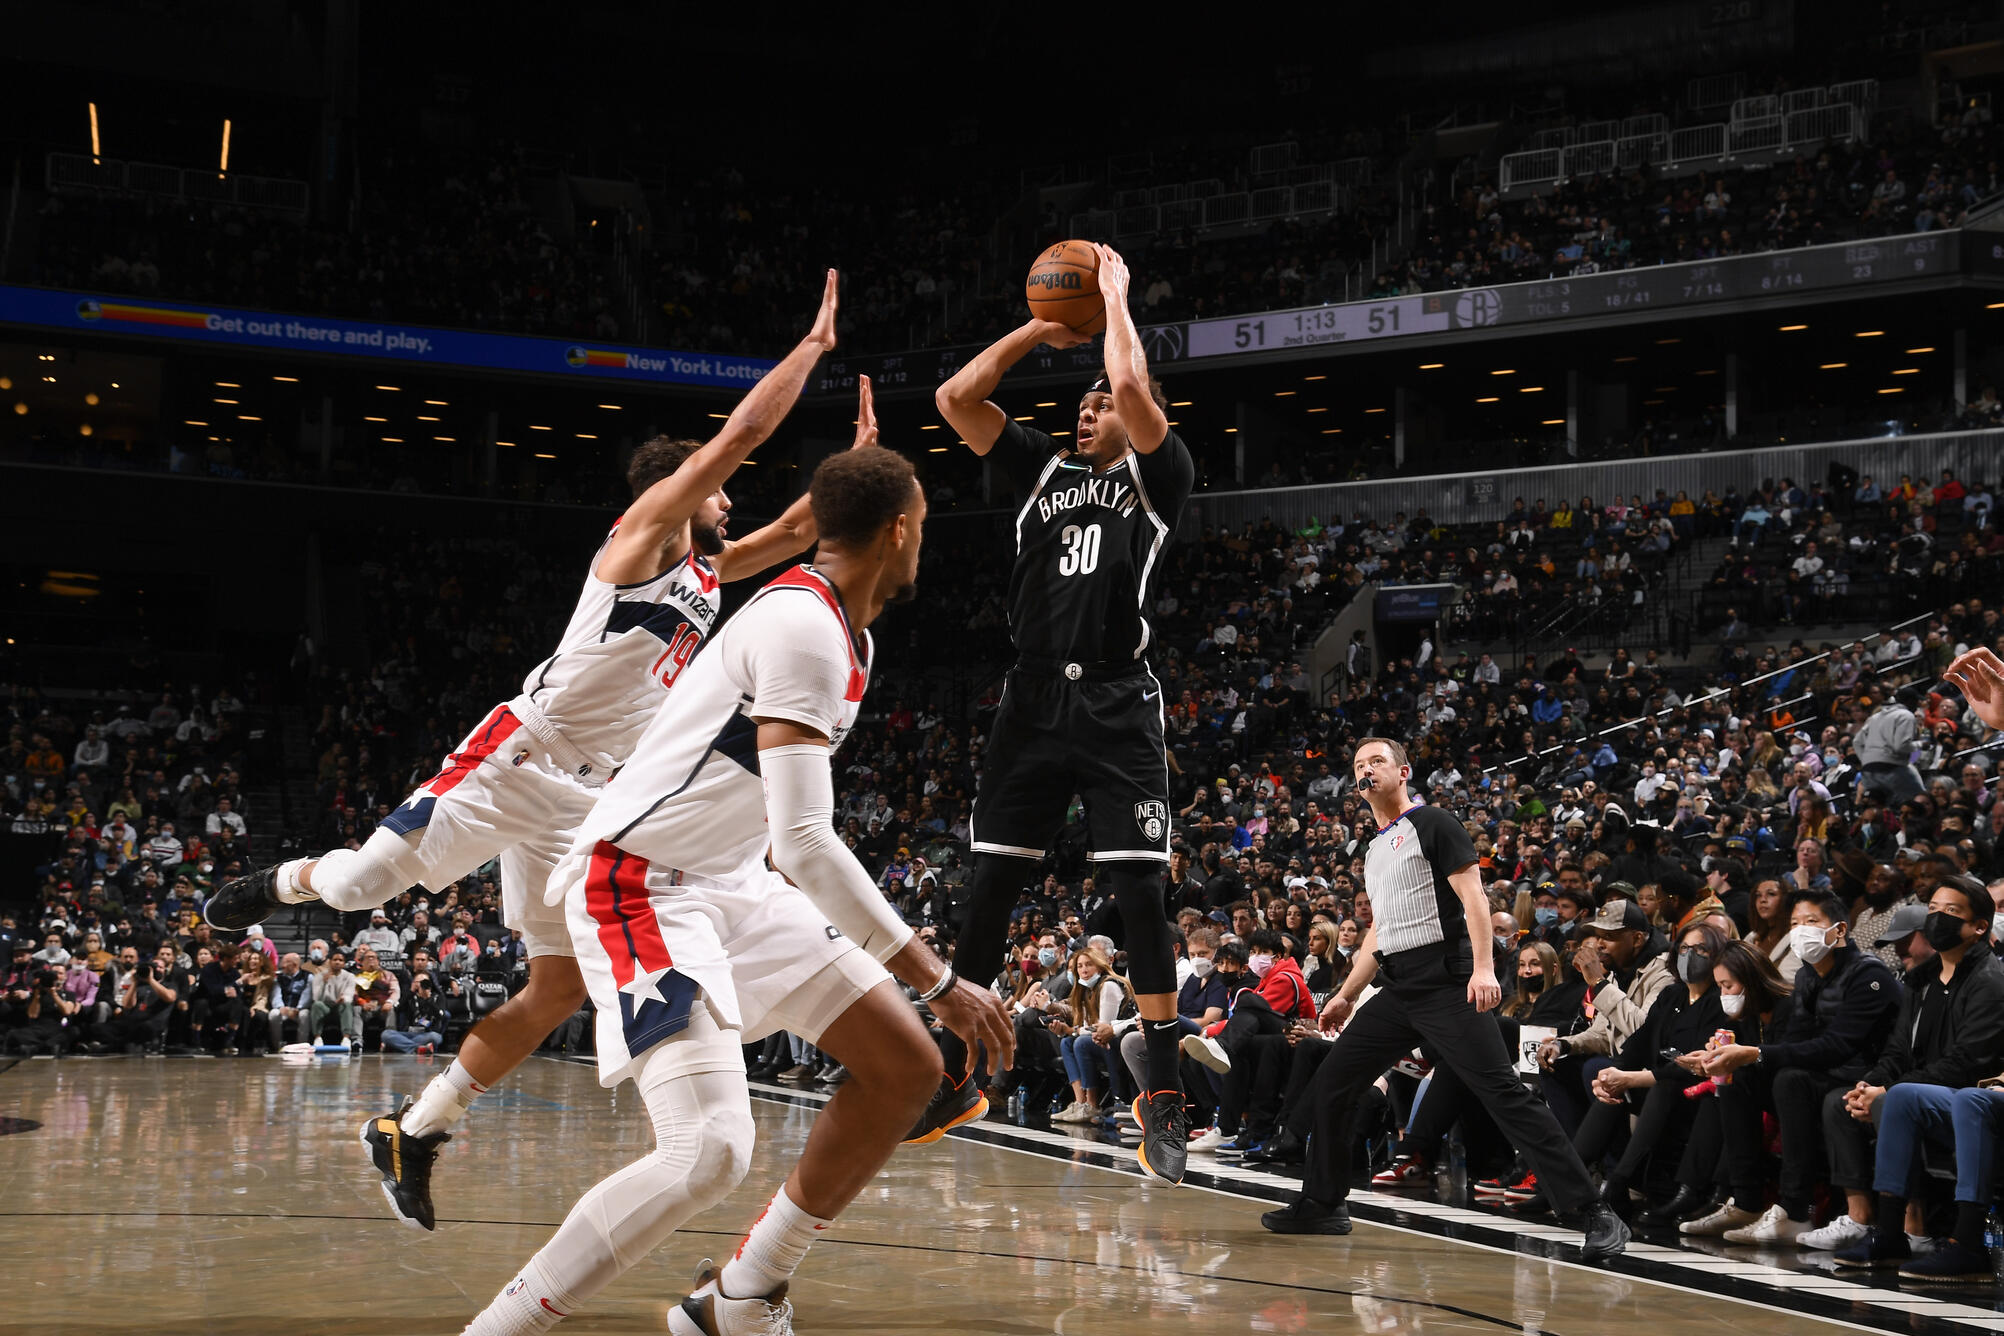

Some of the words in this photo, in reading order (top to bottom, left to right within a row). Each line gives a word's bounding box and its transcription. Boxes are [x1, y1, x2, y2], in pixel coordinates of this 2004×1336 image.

[1853, 265, 1872, 279] 23
[1914, 257, 1925, 271] 9
[1027, 271, 1082, 290] Wilson
[1295, 311, 1336, 333] 1:13
[1367, 306, 1400, 334] 51
[205, 313, 244, 333] Get
[246, 319, 282, 337] out
[285, 321, 341, 343] there
[343, 329, 383, 347] and
[385, 332, 433, 354] play.
[1234, 320, 1265, 349] 51
[1284, 336, 1304, 346] 2nd
[1306, 331, 1347, 344] Quarter
[626, 354, 665, 372] New
[670, 357, 711, 376] York
[1040, 357, 1052, 369] 11
[1038, 479, 1138, 523] BROOKLYN
[1059, 524, 1101, 577] 30
[651, 622, 702, 689] 19
[1137, 803, 1165, 820] NETS
